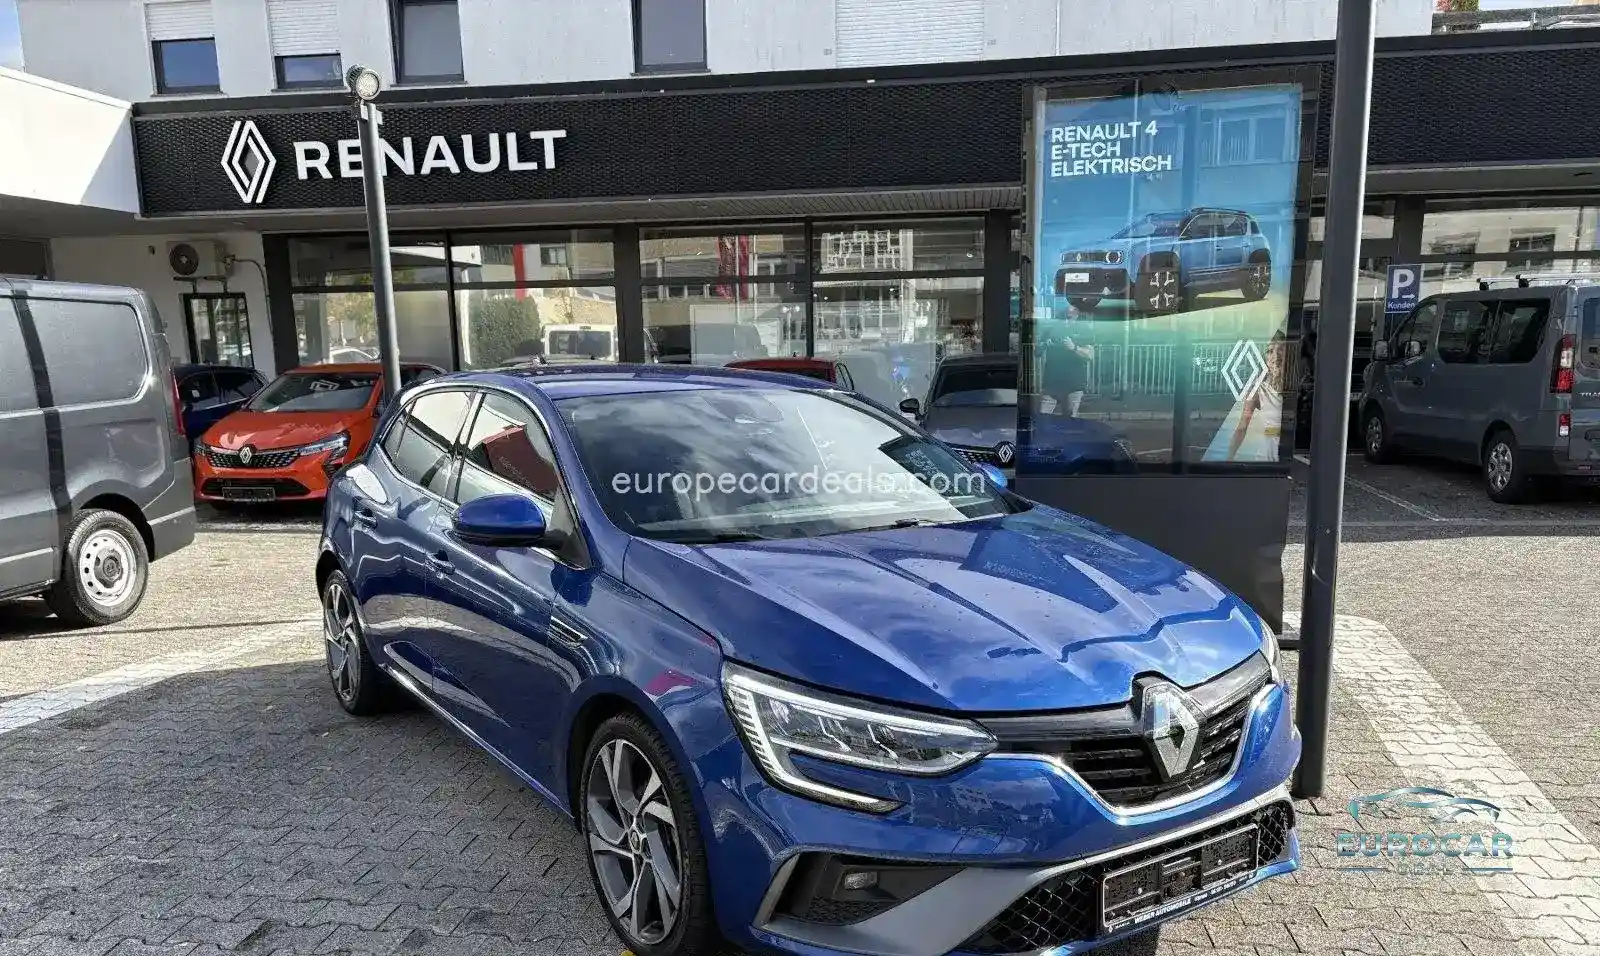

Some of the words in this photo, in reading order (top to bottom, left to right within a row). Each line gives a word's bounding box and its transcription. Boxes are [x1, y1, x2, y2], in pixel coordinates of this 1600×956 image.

[1051, 121, 1141, 143] RENAULT
[1145, 120, 1158, 136] 4
[293, 129, 567, 180] RENAULT
[1051, 141, 1121, 160] E-TECH
[1051, 154, 1172, 177] ELEKTRISCH
[1391, 268, 1415, 299] P
[1387, 301, 1416, 310] Kunden
